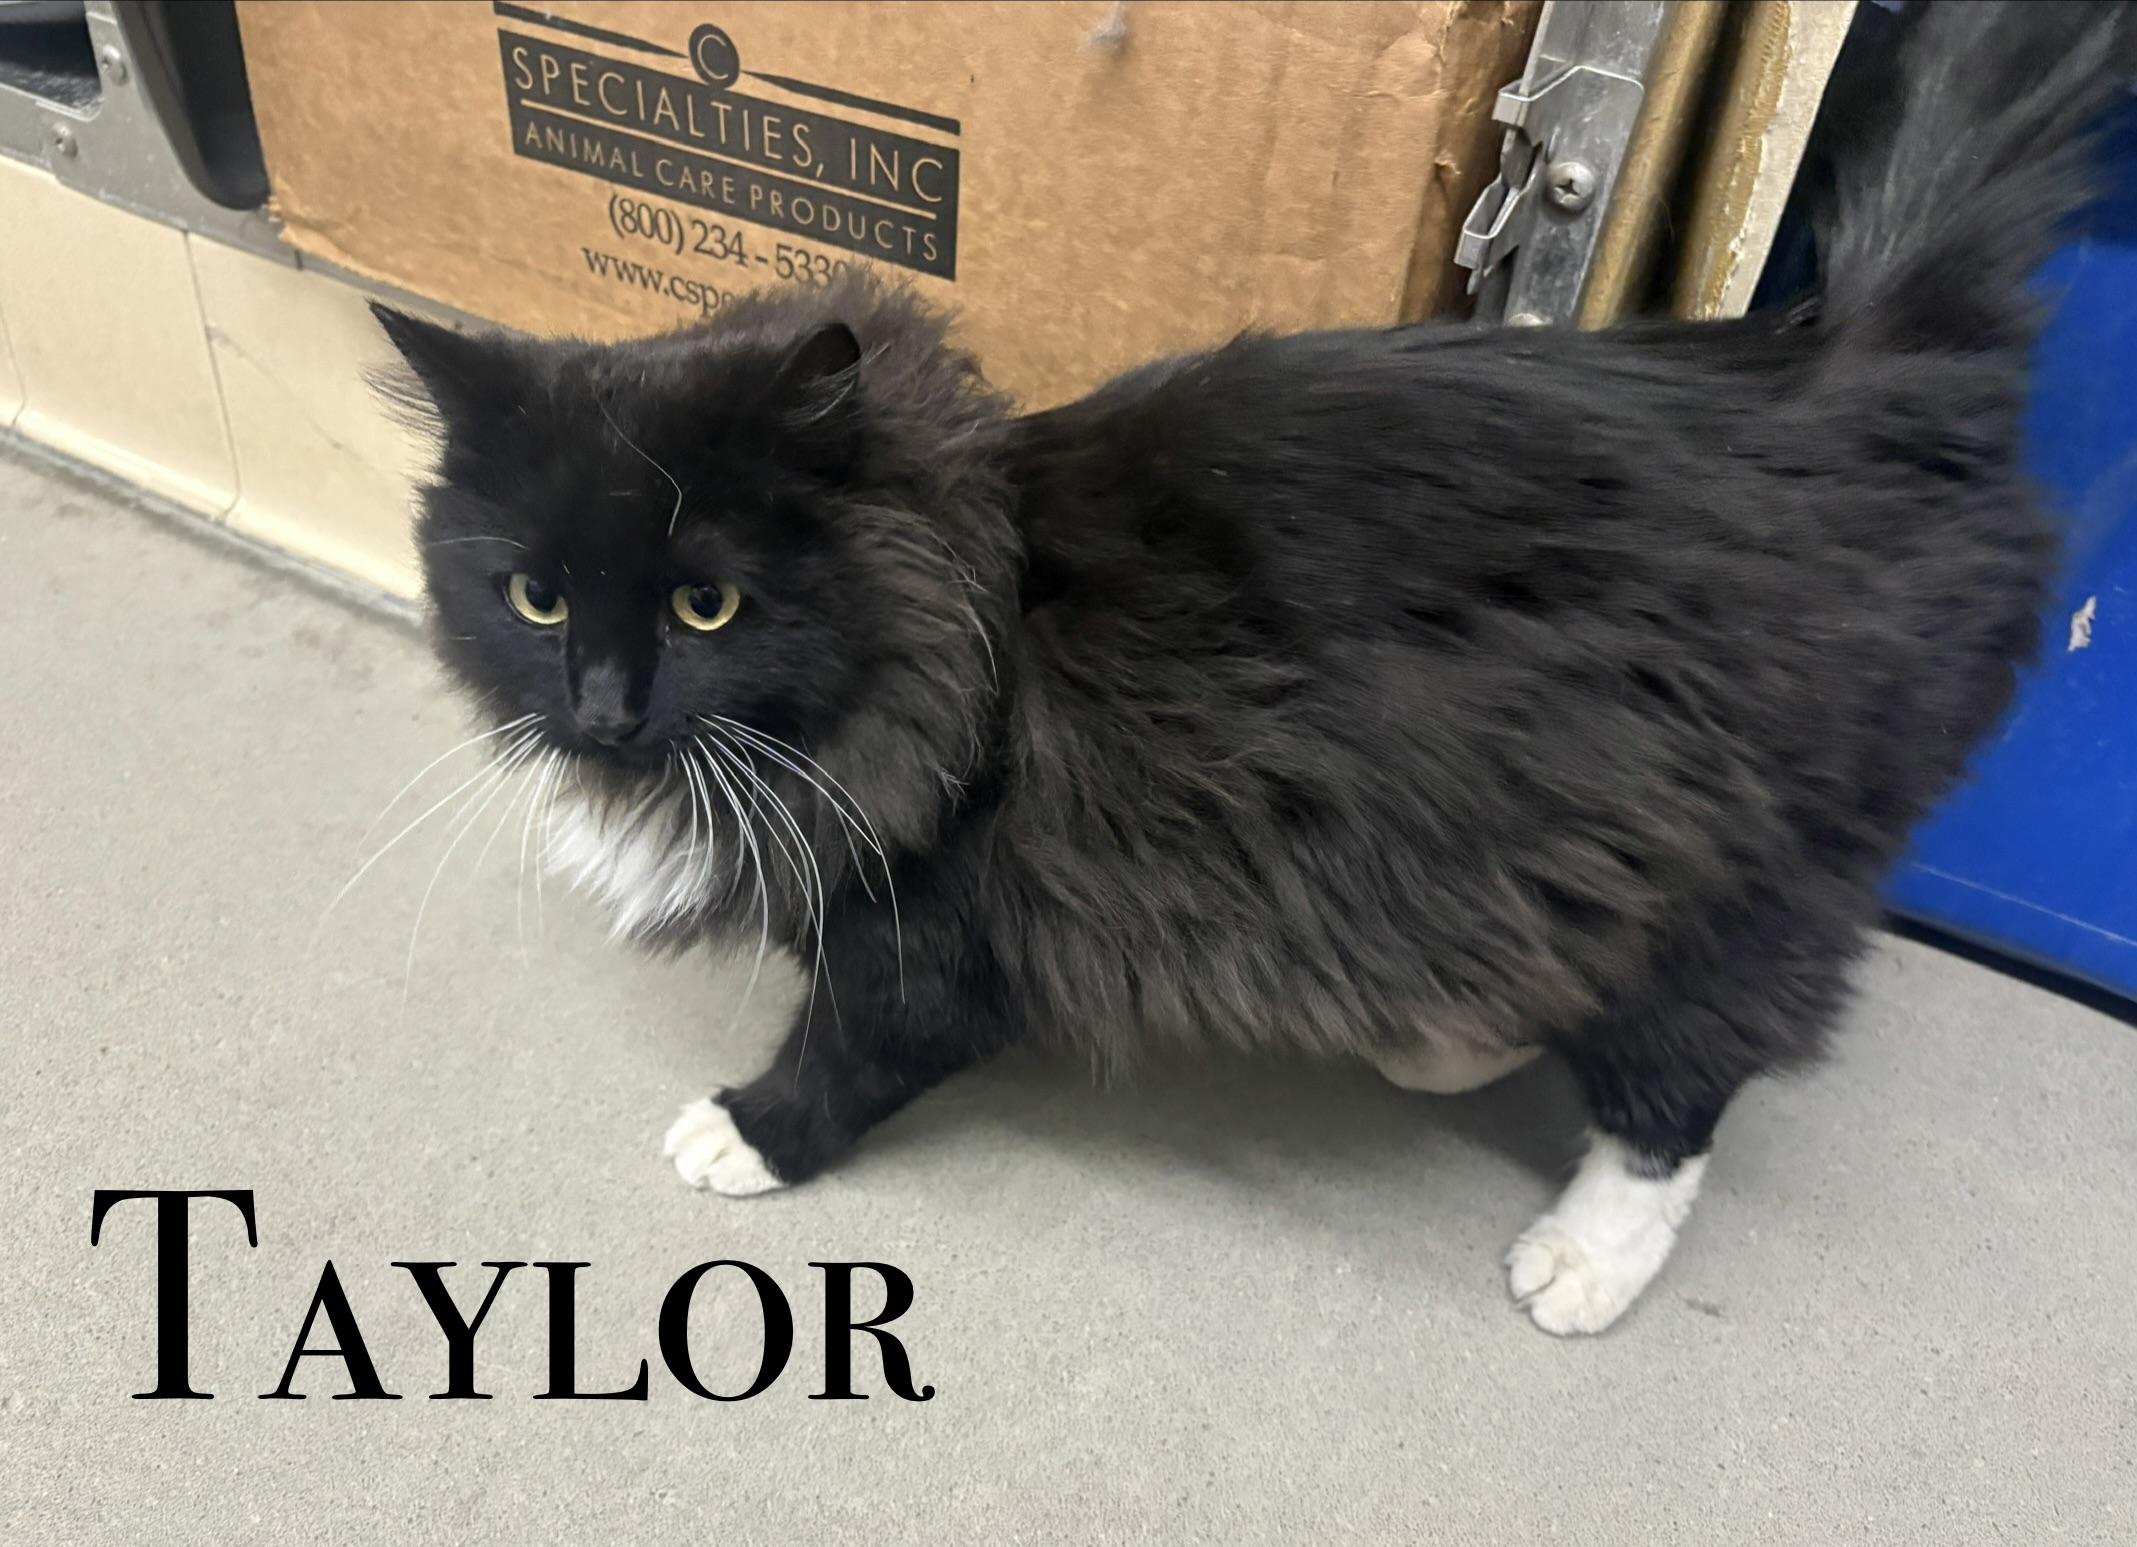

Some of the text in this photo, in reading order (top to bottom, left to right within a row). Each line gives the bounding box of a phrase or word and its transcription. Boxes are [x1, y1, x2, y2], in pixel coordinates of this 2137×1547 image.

[696, 34, 728, 80] C
[512, 47, 944, 203] SPECIALTIES, INC
[523, 121, 938, 262] ANIMAL CARE PRODUCTS
[609, 193, 685, 255] (800)
[692, 219, 748, 267] 234
